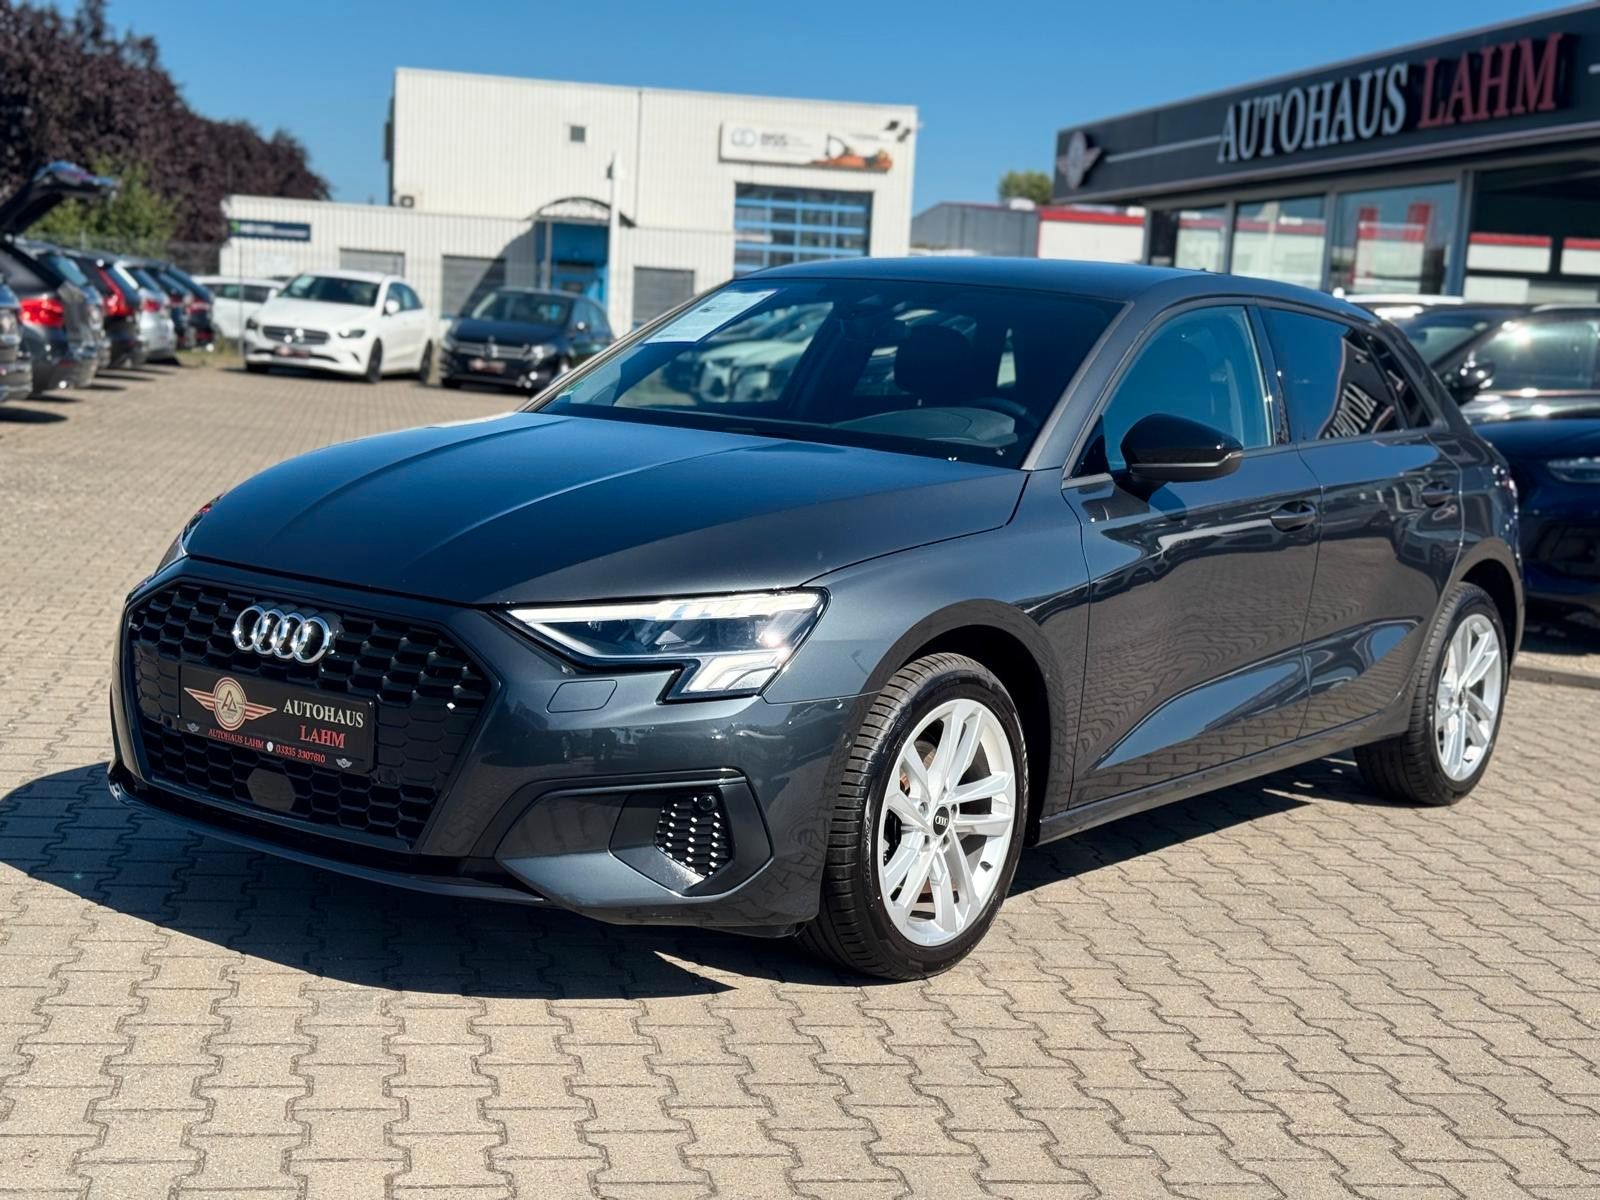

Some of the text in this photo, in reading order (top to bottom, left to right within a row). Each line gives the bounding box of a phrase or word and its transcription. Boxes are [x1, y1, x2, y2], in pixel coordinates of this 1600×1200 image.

[1217, 33, 1562, 163] AUTOHAUS LAHM
[283, 699, 363, 727] AUTOHAUS
[208, 728, 244, 744] AUTOHAUS
[244, 736, 264, 749] LAHM
[300, 725, 346, 748] LAHM
